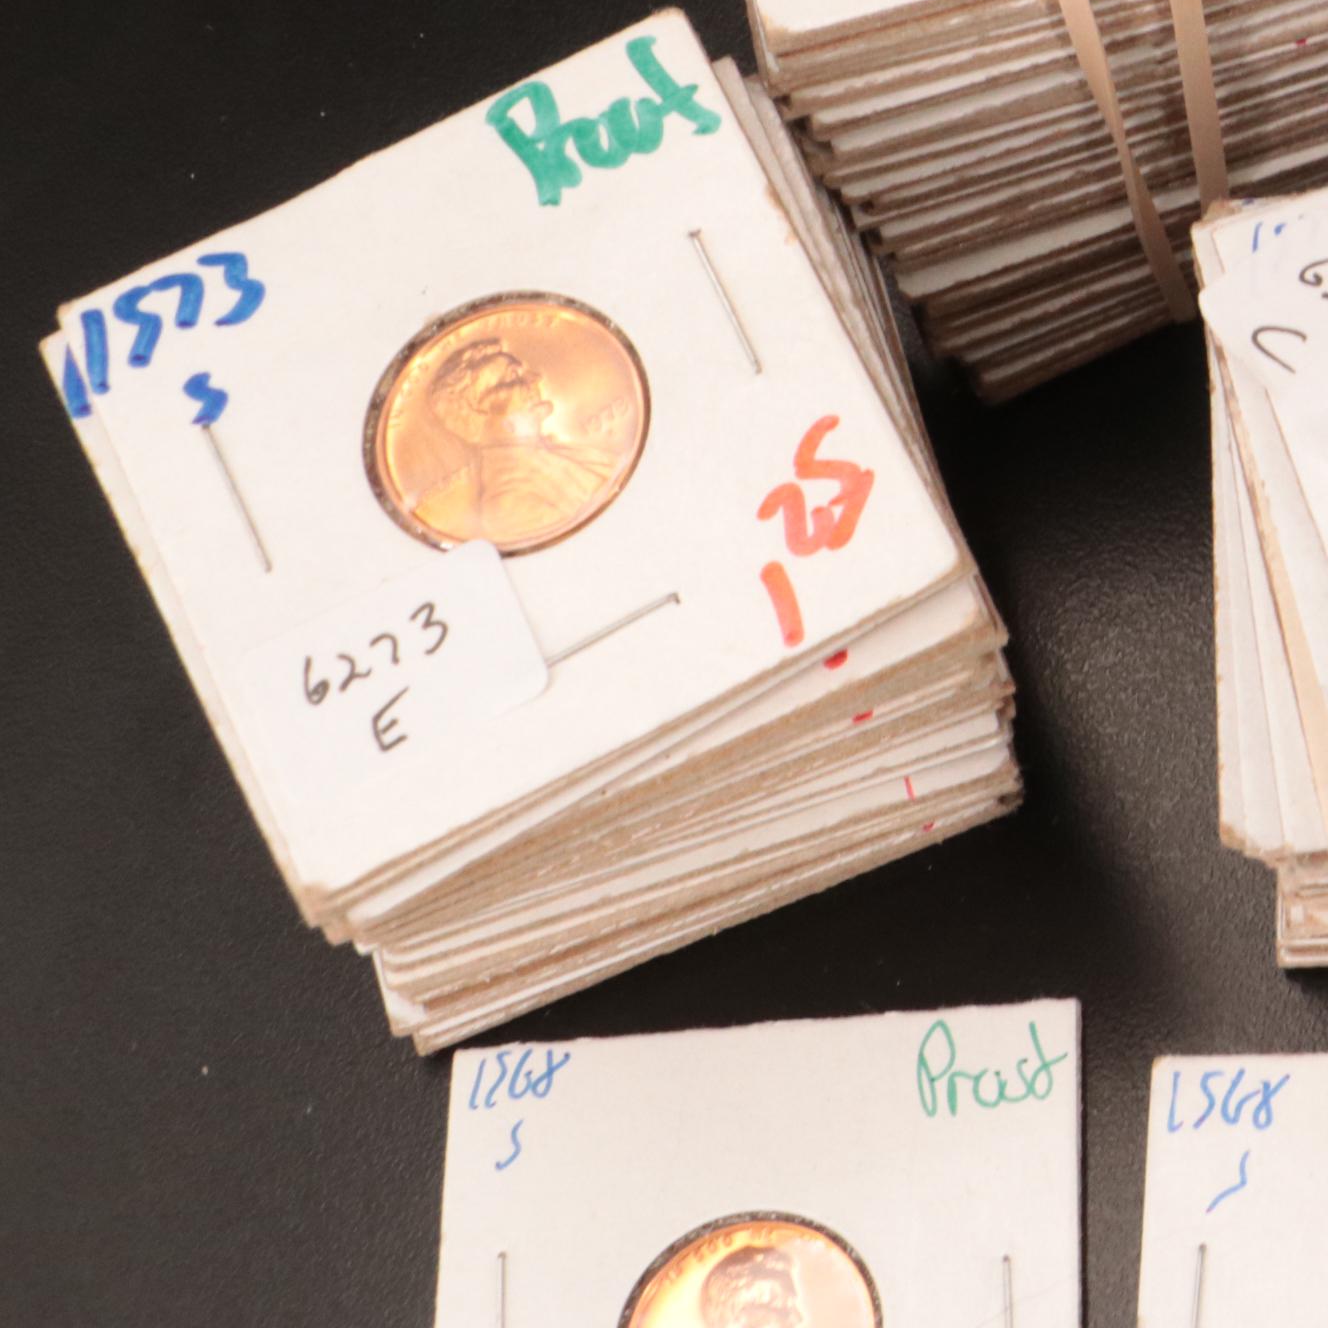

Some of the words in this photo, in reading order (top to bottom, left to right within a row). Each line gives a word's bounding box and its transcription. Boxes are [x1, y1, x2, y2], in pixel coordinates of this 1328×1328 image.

[1251, 325, 1307, 374] C
[183, 373, 229, 424] S
[302, 601, 449, 705] 6273
[371, 687, 409, 752] E
